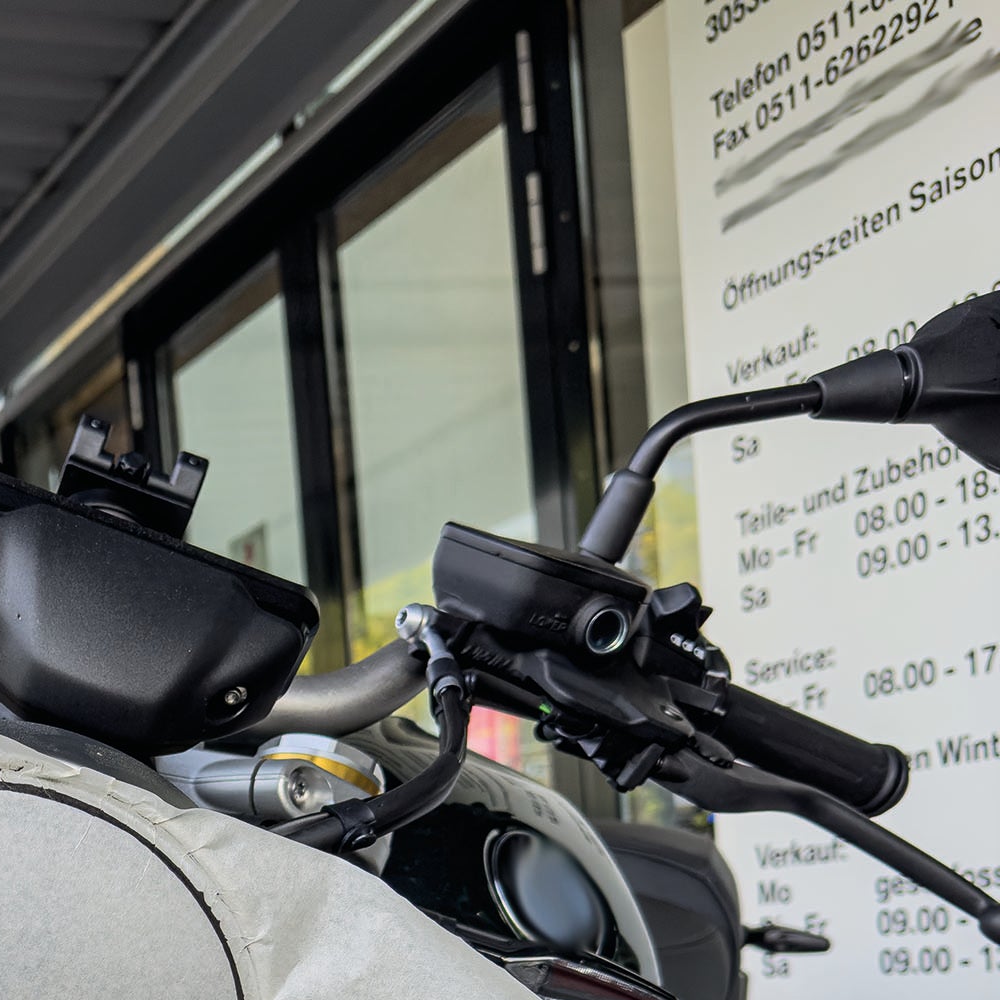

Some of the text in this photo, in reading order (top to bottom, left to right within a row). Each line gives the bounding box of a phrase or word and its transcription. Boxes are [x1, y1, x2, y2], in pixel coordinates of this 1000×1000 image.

[705, 0, 769, 43] 305
[710, 52, 791, 118] Telefon
[797, 0, 894, 61] 0511-
[713, 0, 953, 159] Fax 0511-6262292
[723, 202, 900, 311] Öffnungszeiten
[727, 324, 818, 385] Verkauf:
[732, 434, 761, 463] Sa
[803, 475, 847, 515] und
[739, 547, 770, 575] Mo
[794, 529, 819, 557] Fr
[855, 491, 926, 538] 08.00
[741, 586, 770, 613] Sa
[857, 533, 929, 579] 09.00
[745, 647, 836, 685] Service:
[803, 683, 827, 710] Fr
[864, 660, 934, 699] 08.00
[758, 881, 791, 904] Mo
[877, 907, 948, 935] 09.00
[763, 951, 788, 977] Sa
[881, 946, 951, 974] 09.00
[981, 947, 1000, 972] 1
